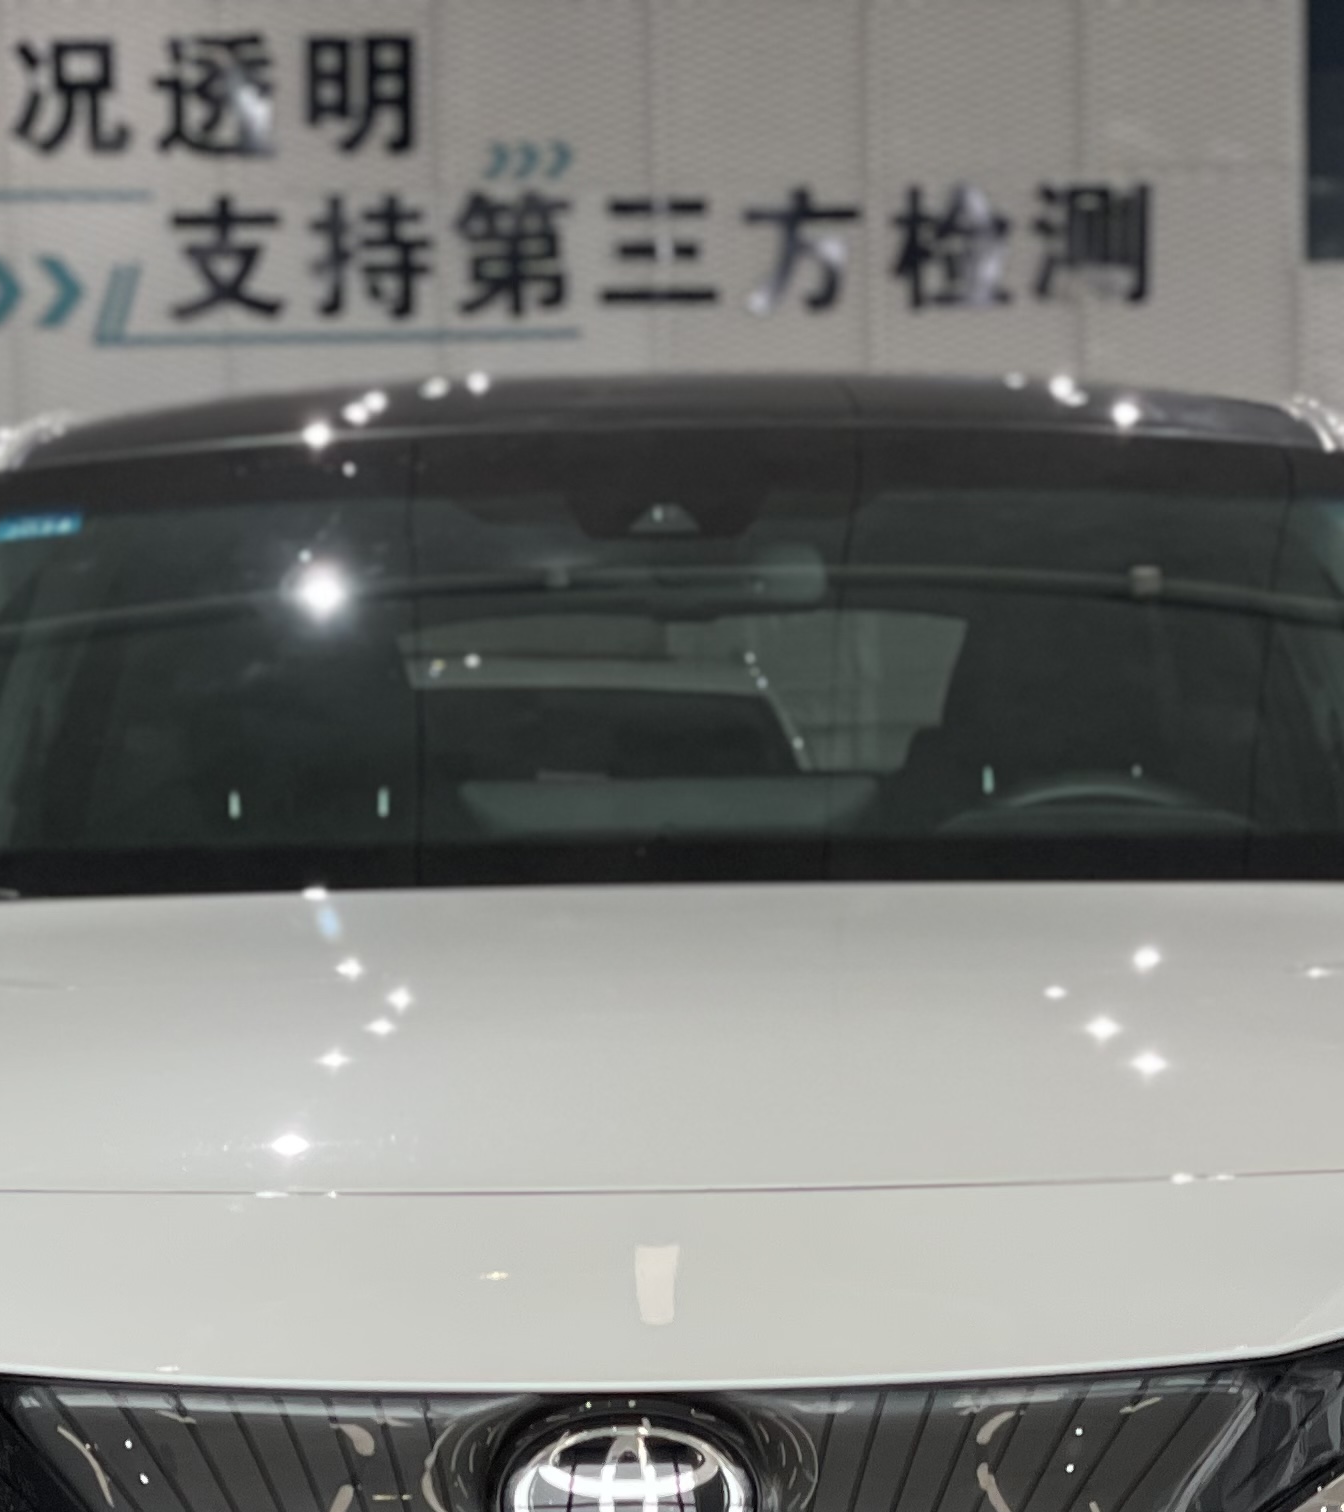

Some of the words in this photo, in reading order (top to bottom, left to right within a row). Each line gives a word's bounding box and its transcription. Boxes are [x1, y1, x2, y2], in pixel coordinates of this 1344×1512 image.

[171, 184, 1152, 319] 支持第三方检测
